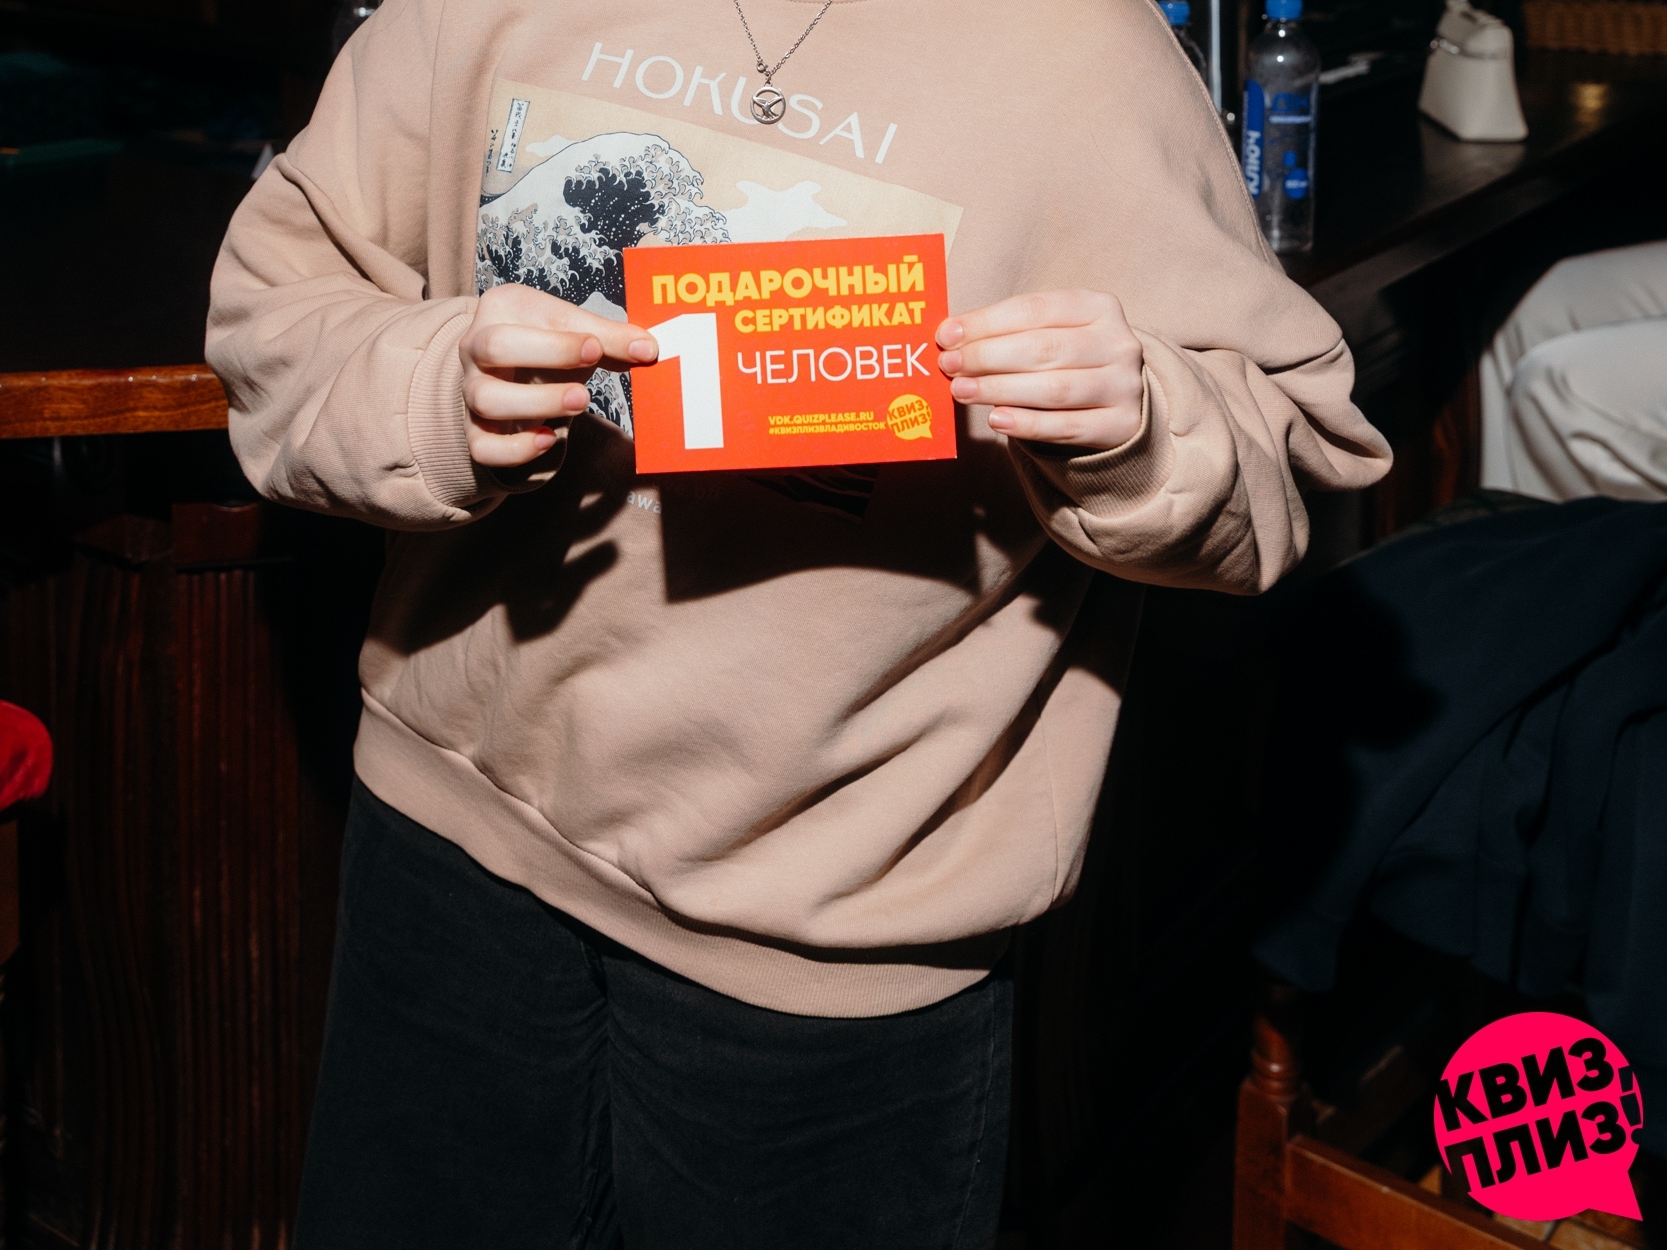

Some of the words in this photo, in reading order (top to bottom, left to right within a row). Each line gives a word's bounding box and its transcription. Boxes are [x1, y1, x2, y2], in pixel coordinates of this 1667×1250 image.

[581, 42, 898, 164] HOKUSAI
[652, 255, 925, 307] ПОДАРОЧНЫЙ
[734, 301, 926, 333] СЕРТИФИКАТ
[647, 312, 724, 450] 1
[737, 343, 930, 384] ЧЕЛОВЕК
[768, 411, 874, 426] VDK.QUIZPLEASE.RU
[768, 421, 886, 435] #КВИЗПЛИЗВЛАДИВОСТОК
